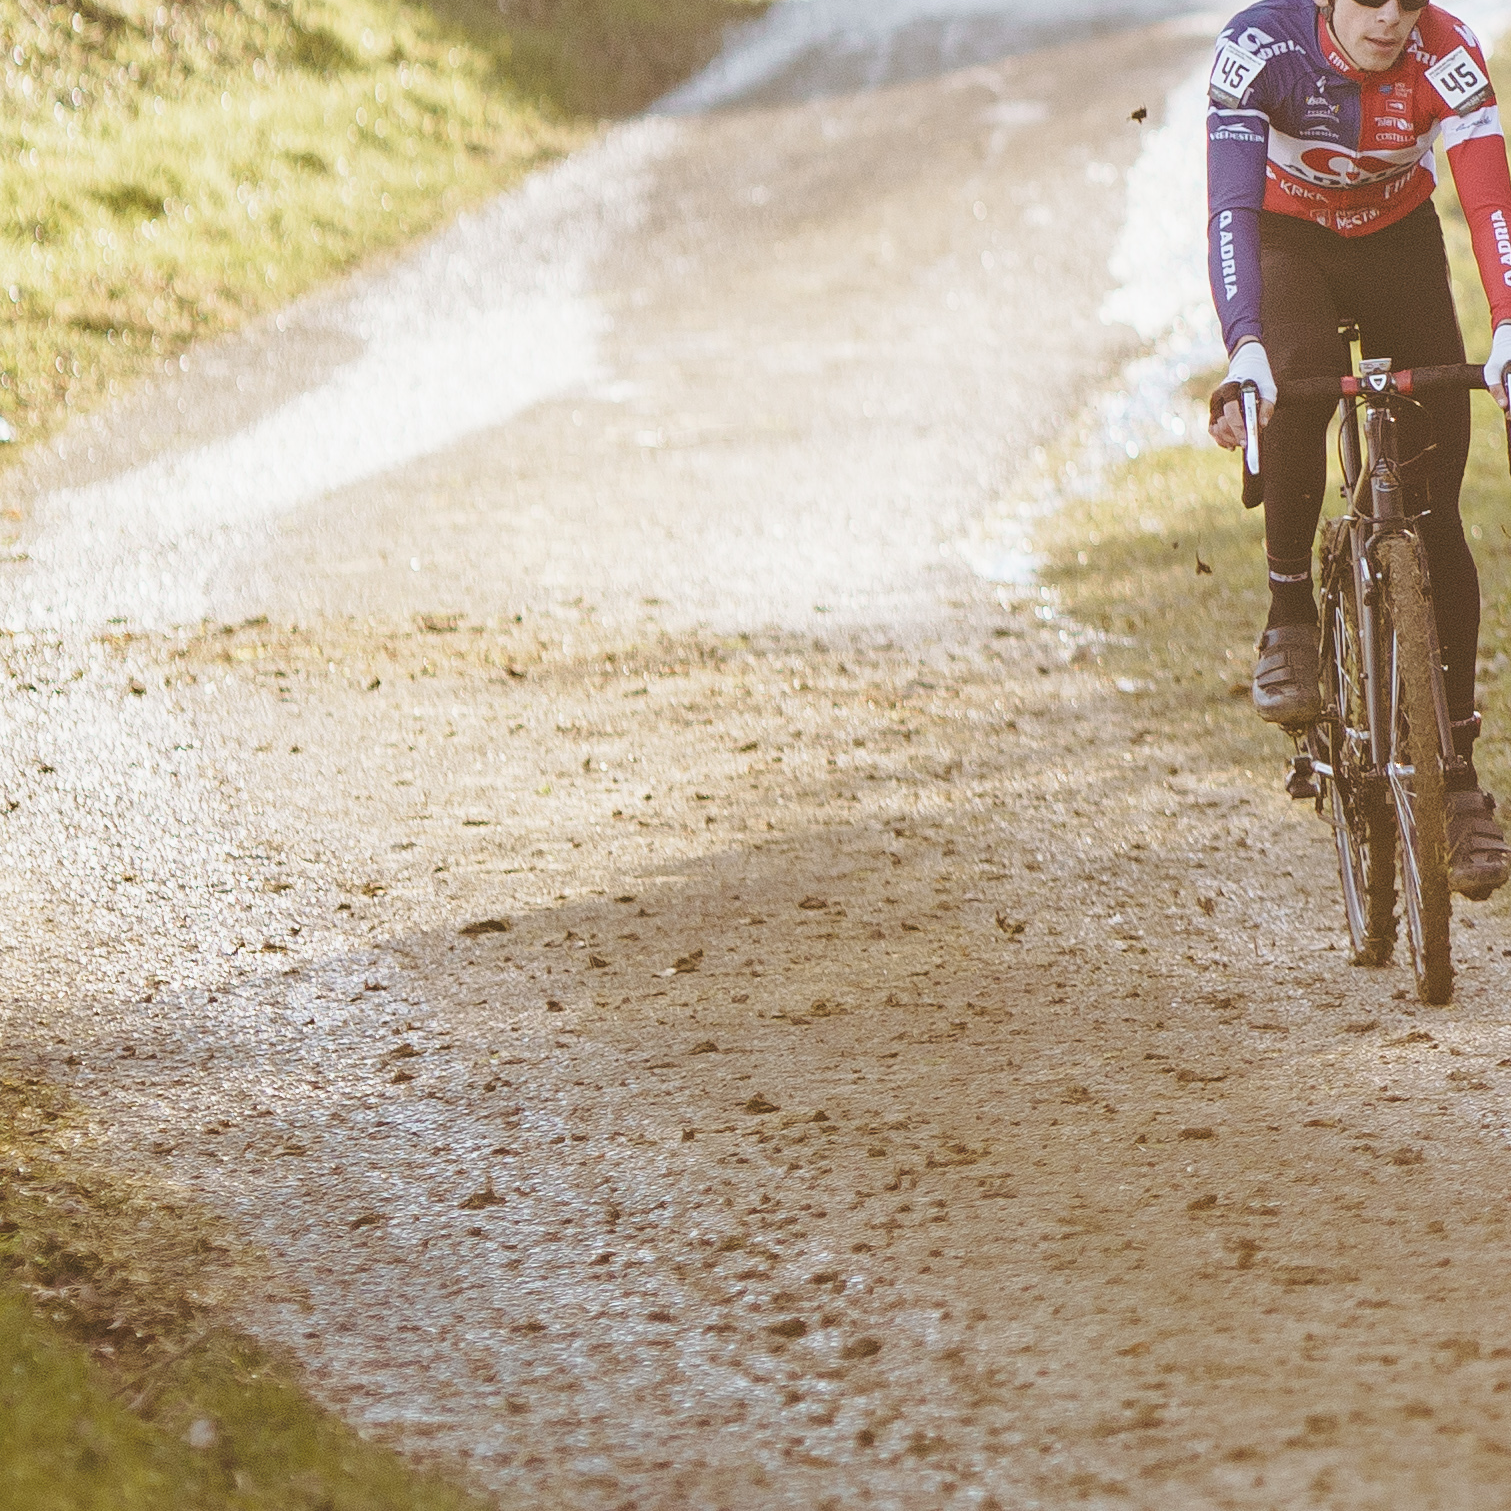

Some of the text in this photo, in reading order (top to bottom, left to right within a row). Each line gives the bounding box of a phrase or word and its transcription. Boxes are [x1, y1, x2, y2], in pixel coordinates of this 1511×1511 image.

[1221, 56, 1251, 89] 45
[1439, 61, 1478, 94] 45
[1219, 230, 1239, 302] ADRIA
